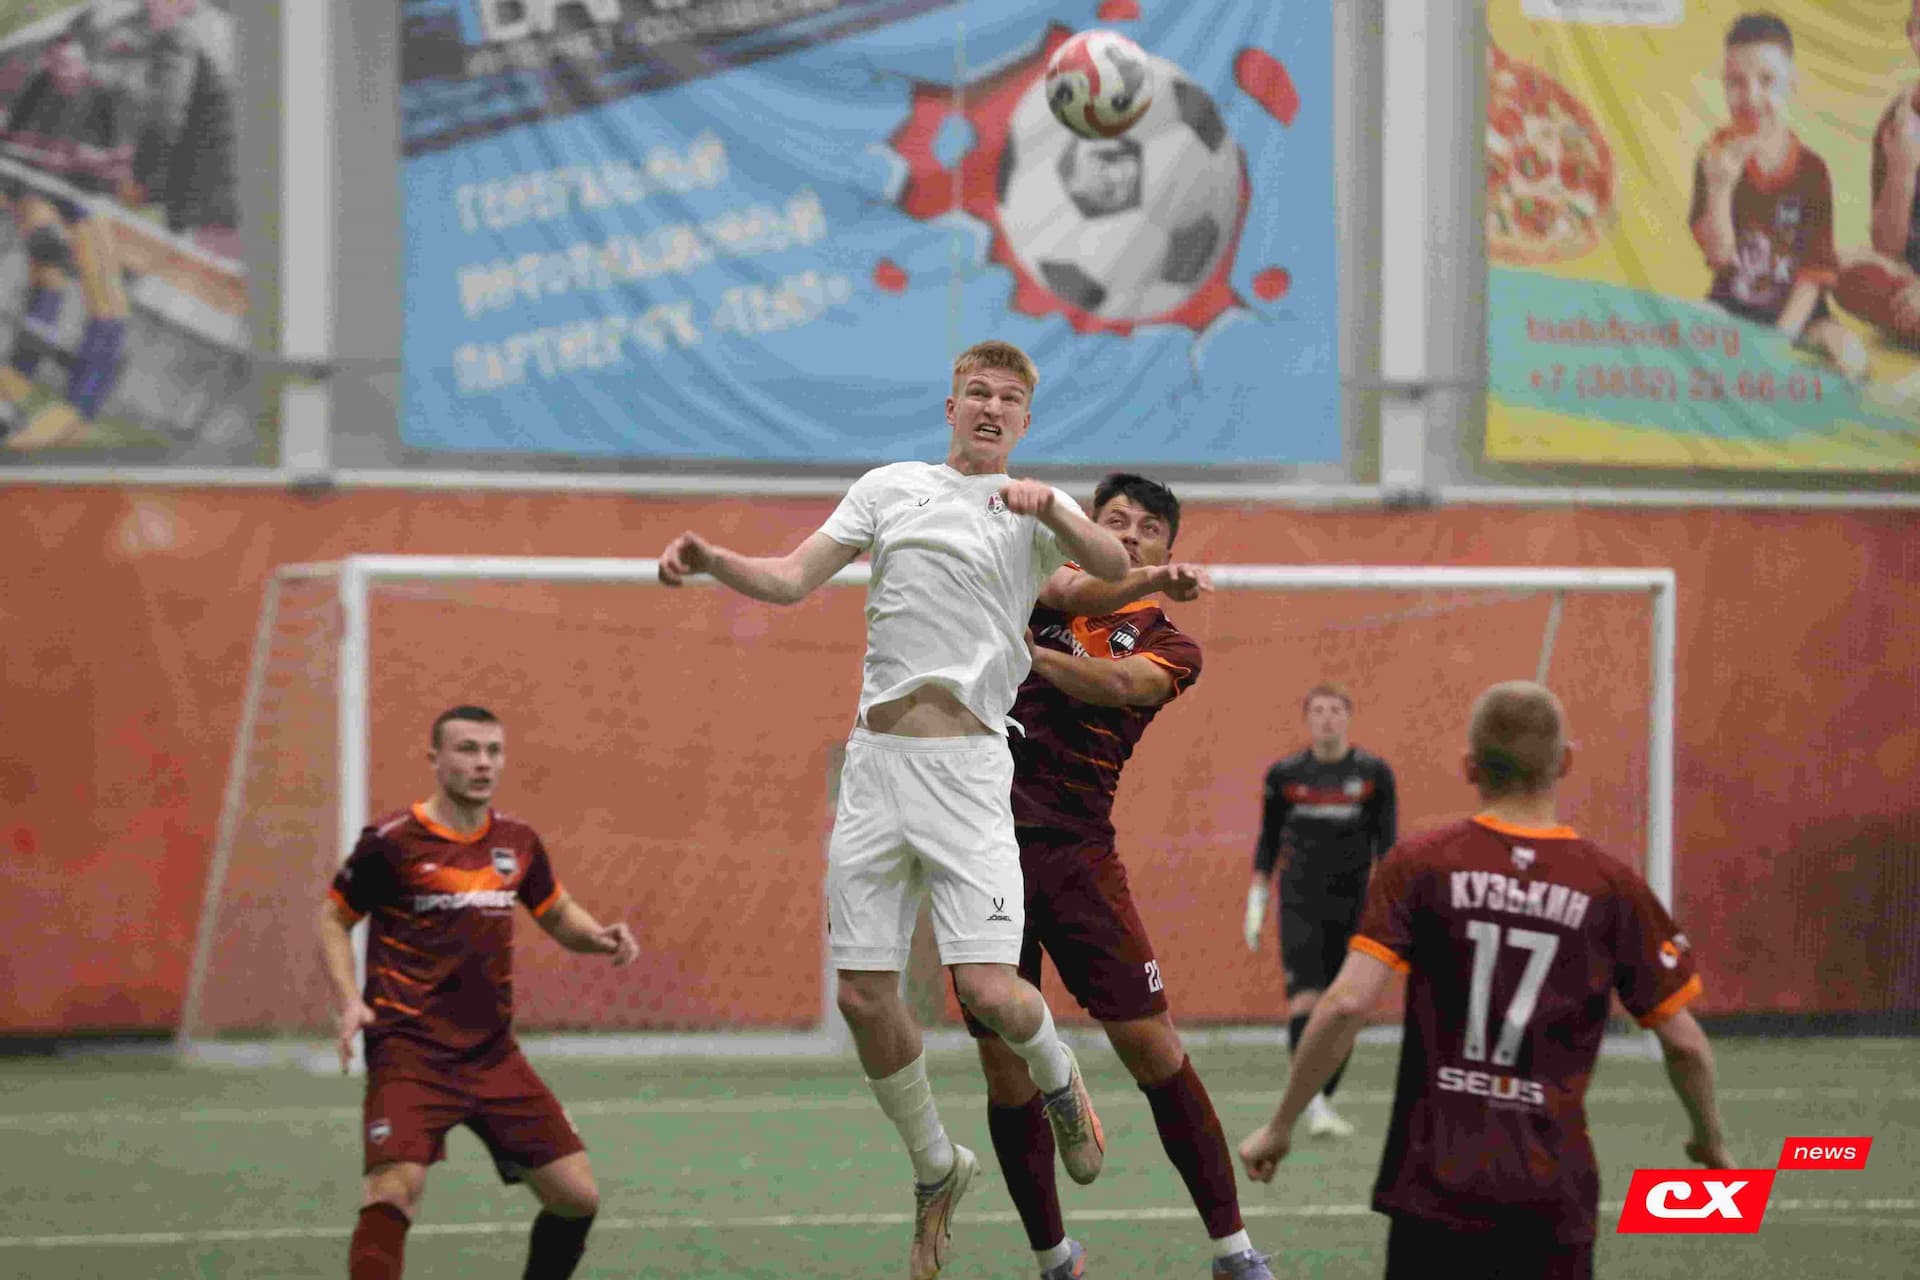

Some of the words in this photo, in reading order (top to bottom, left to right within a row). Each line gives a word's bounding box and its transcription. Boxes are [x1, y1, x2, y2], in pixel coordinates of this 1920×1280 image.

[1450, 871, 1591, 930] КУЗЬКИН
[1464, 920, 1559, 1066] 17
[1437, 1066, 1545, 1104] SEUS
